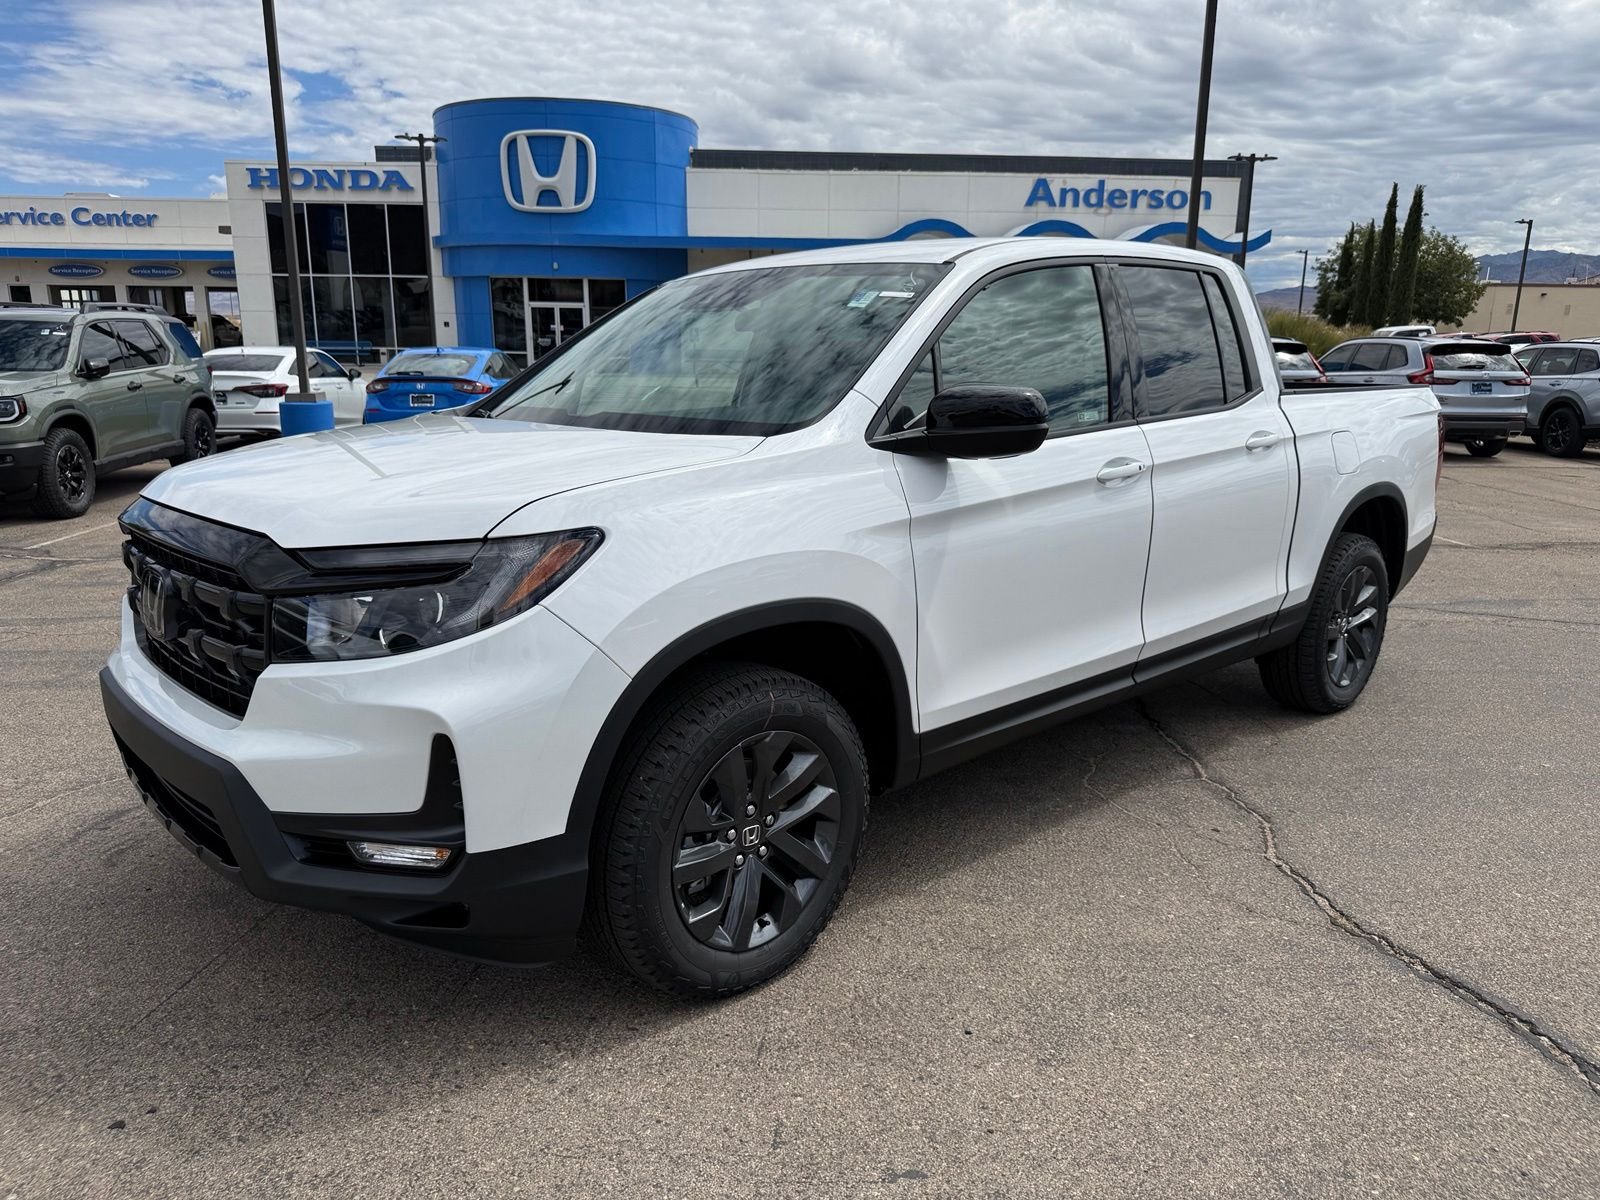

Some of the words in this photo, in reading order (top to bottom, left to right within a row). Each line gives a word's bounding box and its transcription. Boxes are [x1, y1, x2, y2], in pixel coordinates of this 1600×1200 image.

[246, 167, 414, 191] HONDA
[0, 206, 65, 225] rvice
[71, 207, 158, 227] Center
